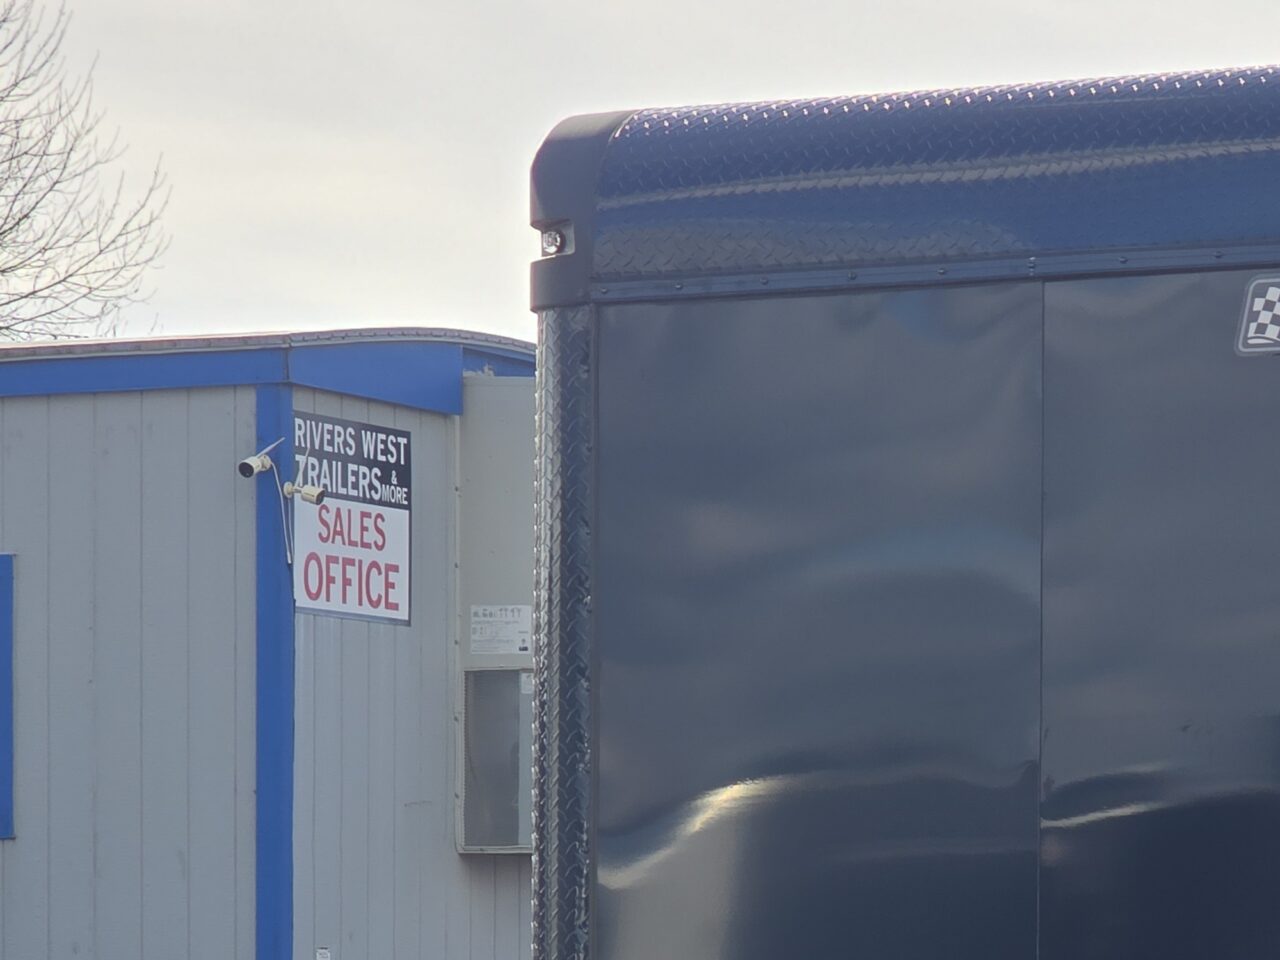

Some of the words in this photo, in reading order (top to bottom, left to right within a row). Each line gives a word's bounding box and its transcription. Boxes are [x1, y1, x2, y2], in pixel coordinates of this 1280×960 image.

[294, 417, 356, 456] RIVERS
[361, 430, 407, 466] WEST
[295, 454, 382, 501] TRAILERS
[381, 484, 408, 505] MORE
[391, 470, 398, 484] &
[318, 503, 386, 552] SALES
[303, 551, 400, 611] OFFICE
